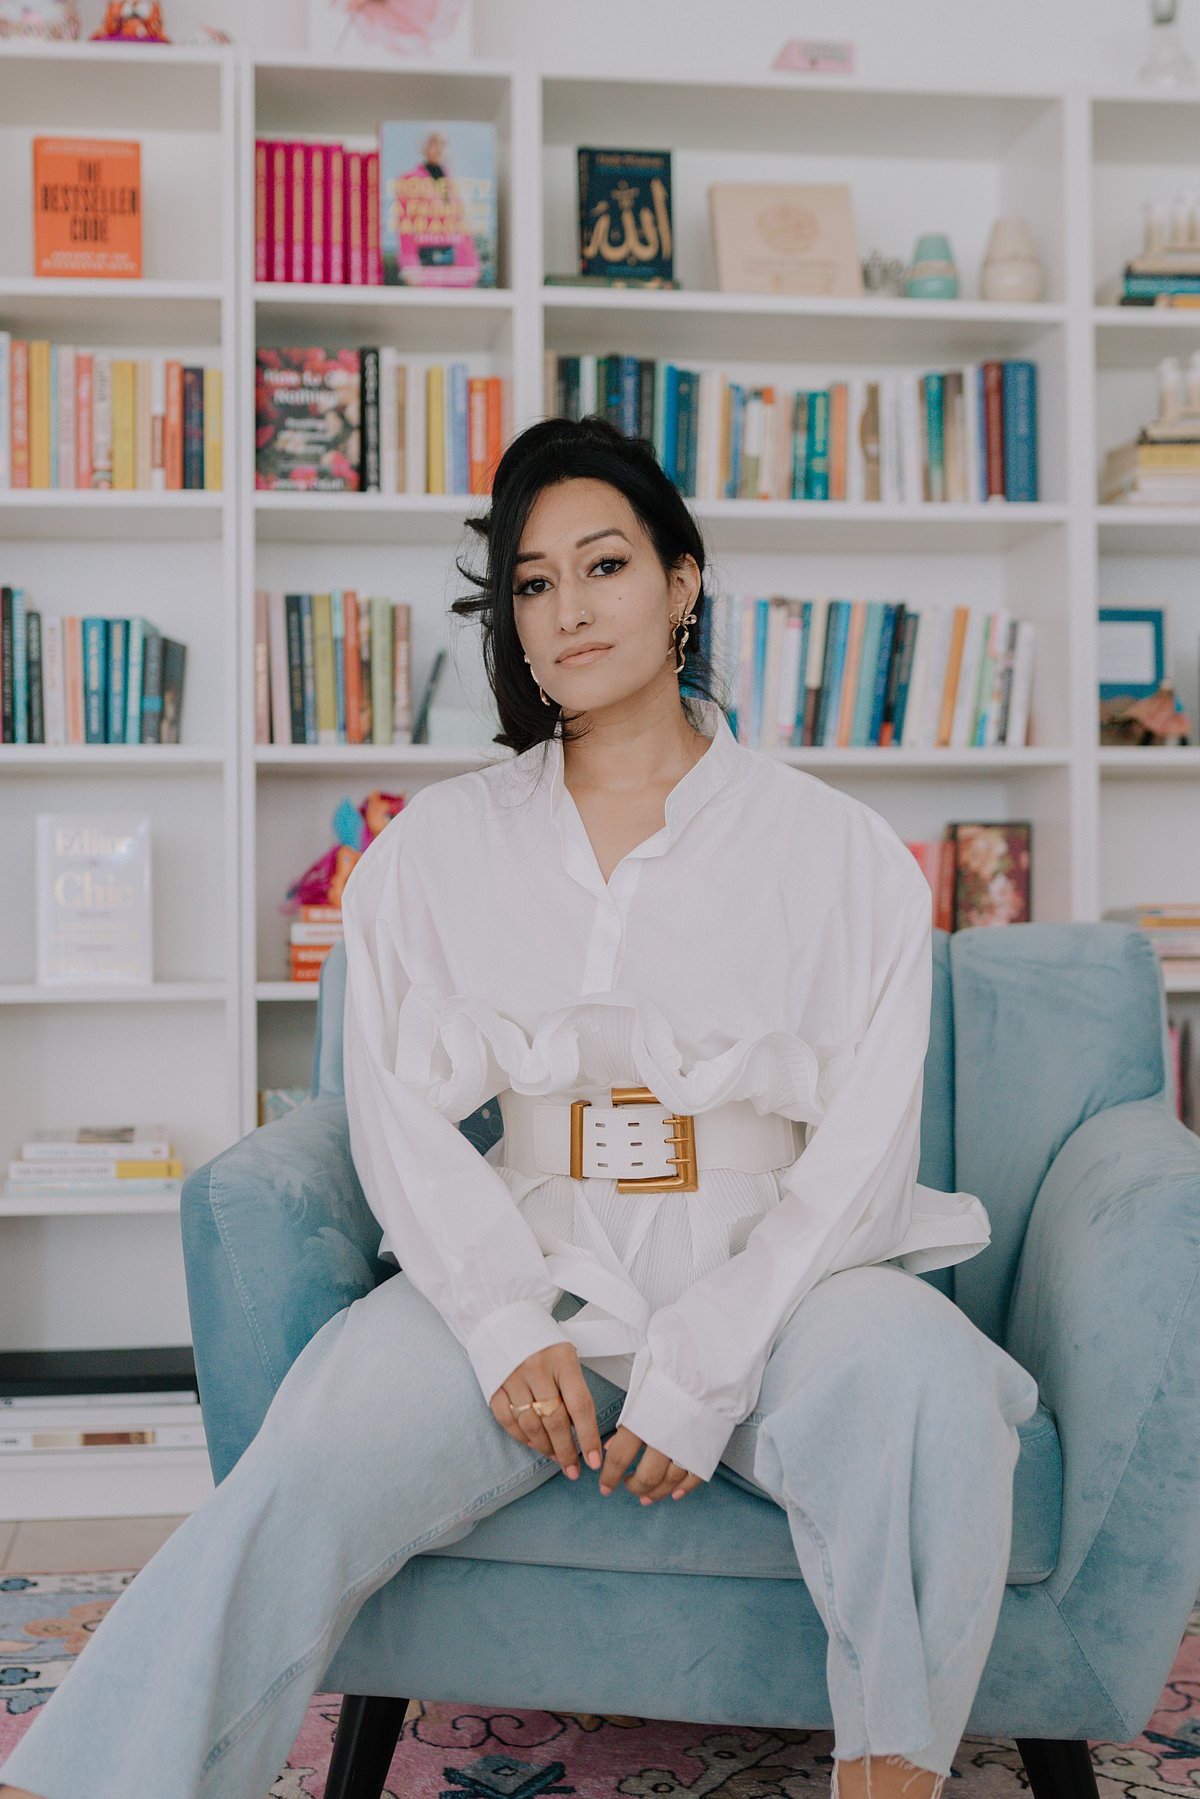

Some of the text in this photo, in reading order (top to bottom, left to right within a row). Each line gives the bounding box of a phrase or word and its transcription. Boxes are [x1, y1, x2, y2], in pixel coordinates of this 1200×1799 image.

[41, 185, 140, 216] BESTSELLER
[386, 177, 490, 198] MODETY
[71, 217, 108, 242] CODE
[54, 871, 135, 910] Chic
